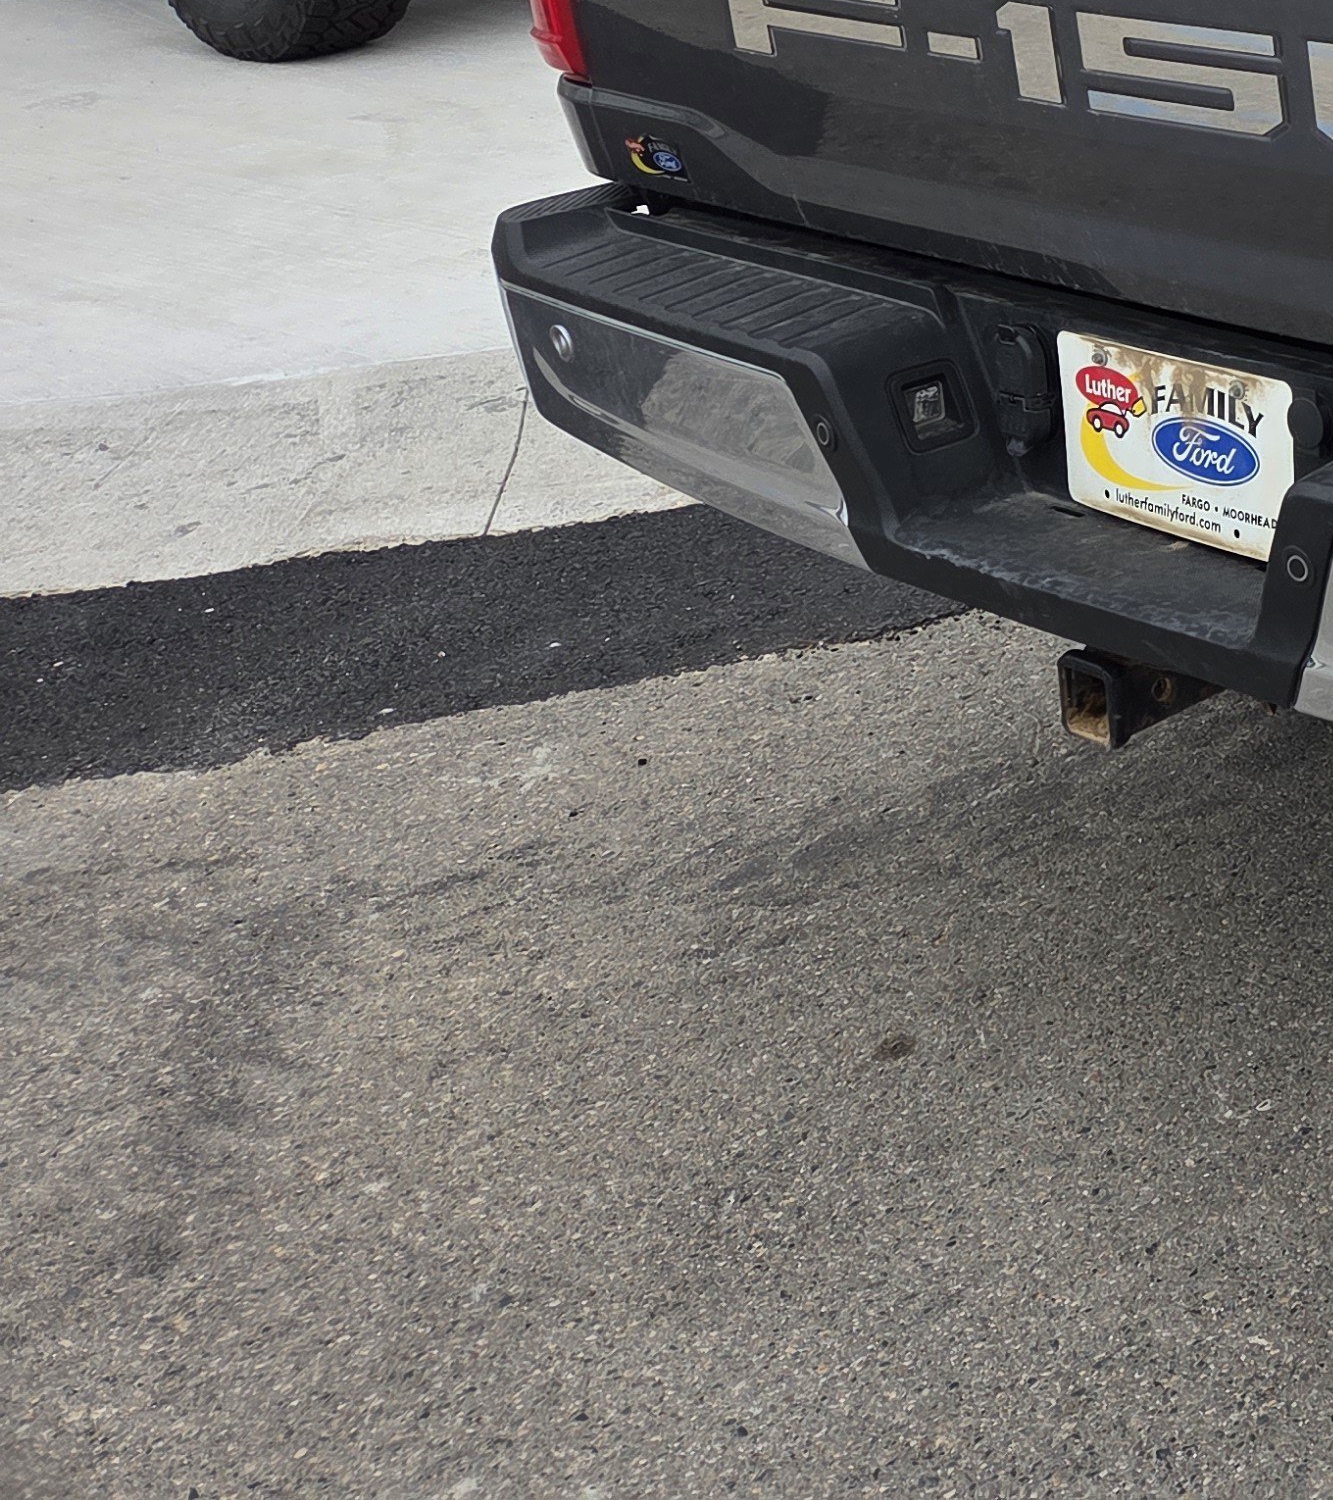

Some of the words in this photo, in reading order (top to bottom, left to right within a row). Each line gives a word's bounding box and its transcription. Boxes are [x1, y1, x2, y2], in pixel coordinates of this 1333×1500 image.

[1085, 374, 1132, 403] Luther
[1150, 384, 1265, 439] FAMILY
[1172, 425, 1238, 476] Ford
[1115, 488, 1221, 534] lutherfamilyford.com
[1181, 493, 1211, 512] FARGO
[1222, 506, 1278, 530] MOORHEAD
